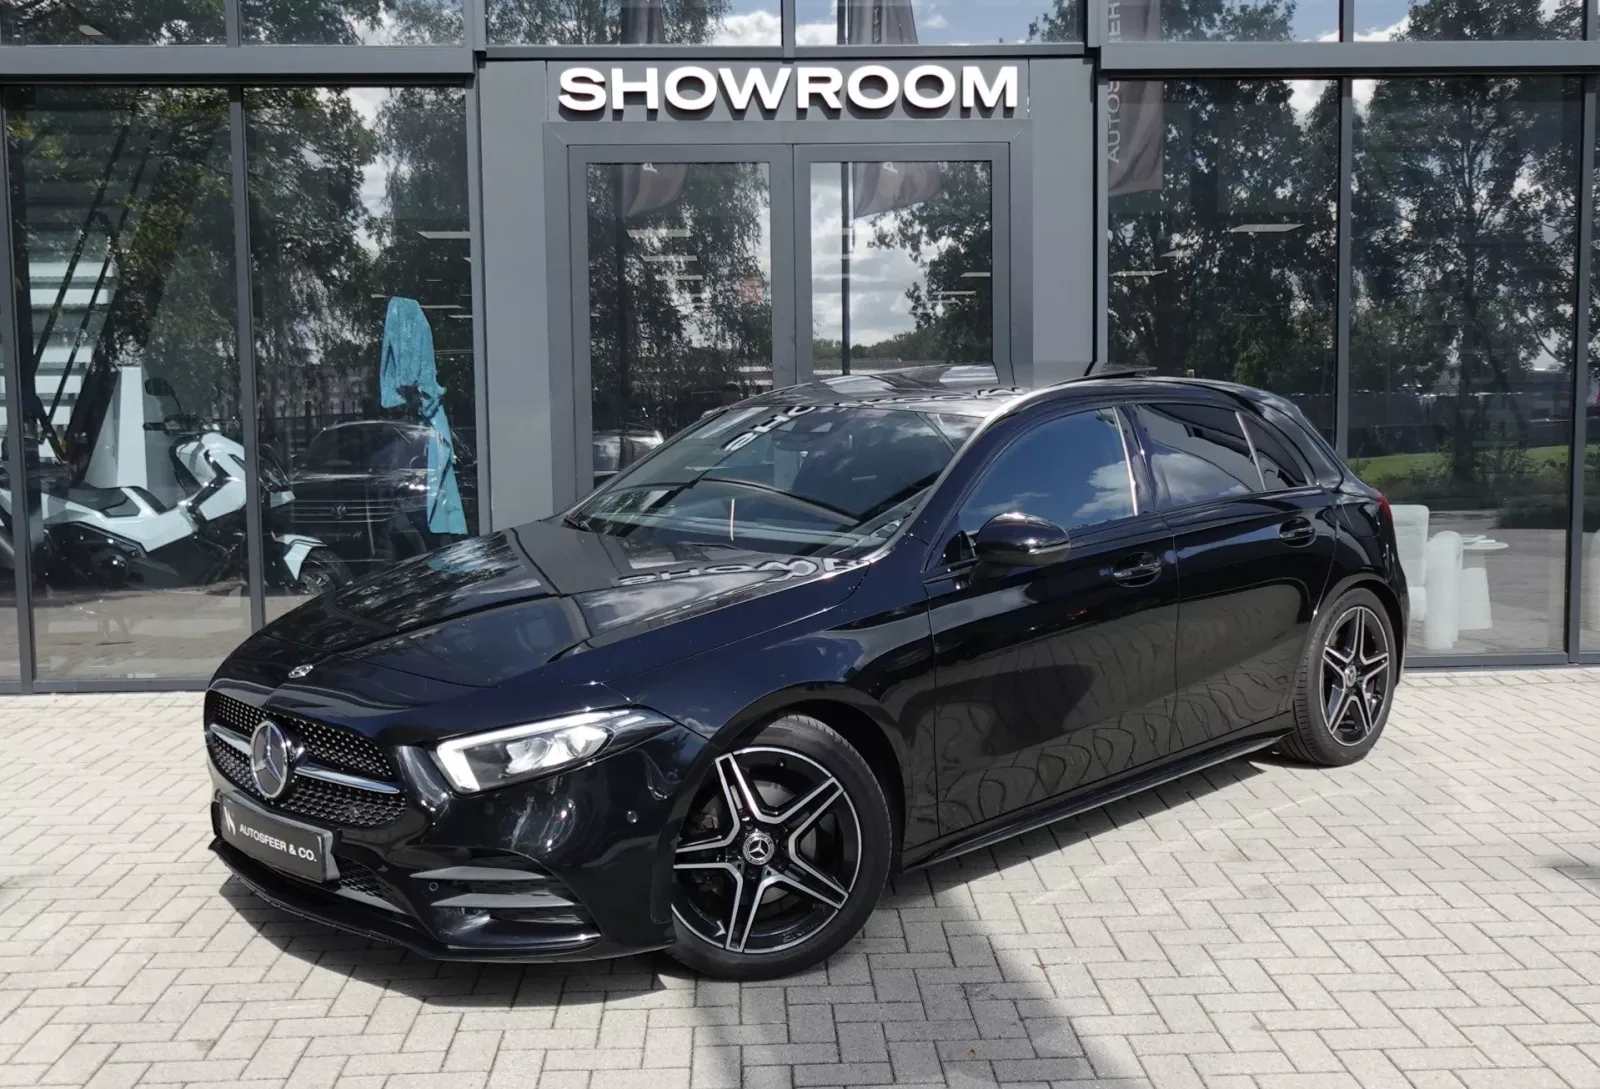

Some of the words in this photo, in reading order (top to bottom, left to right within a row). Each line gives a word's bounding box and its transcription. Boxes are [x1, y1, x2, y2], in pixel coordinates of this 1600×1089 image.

[558, 65, 1019, 112] SHOWROOM
[239, 823, 288, 853] AUTOSFEER
[288, 843, 297, 856] &
[298, 847, 318, 862] CO.
